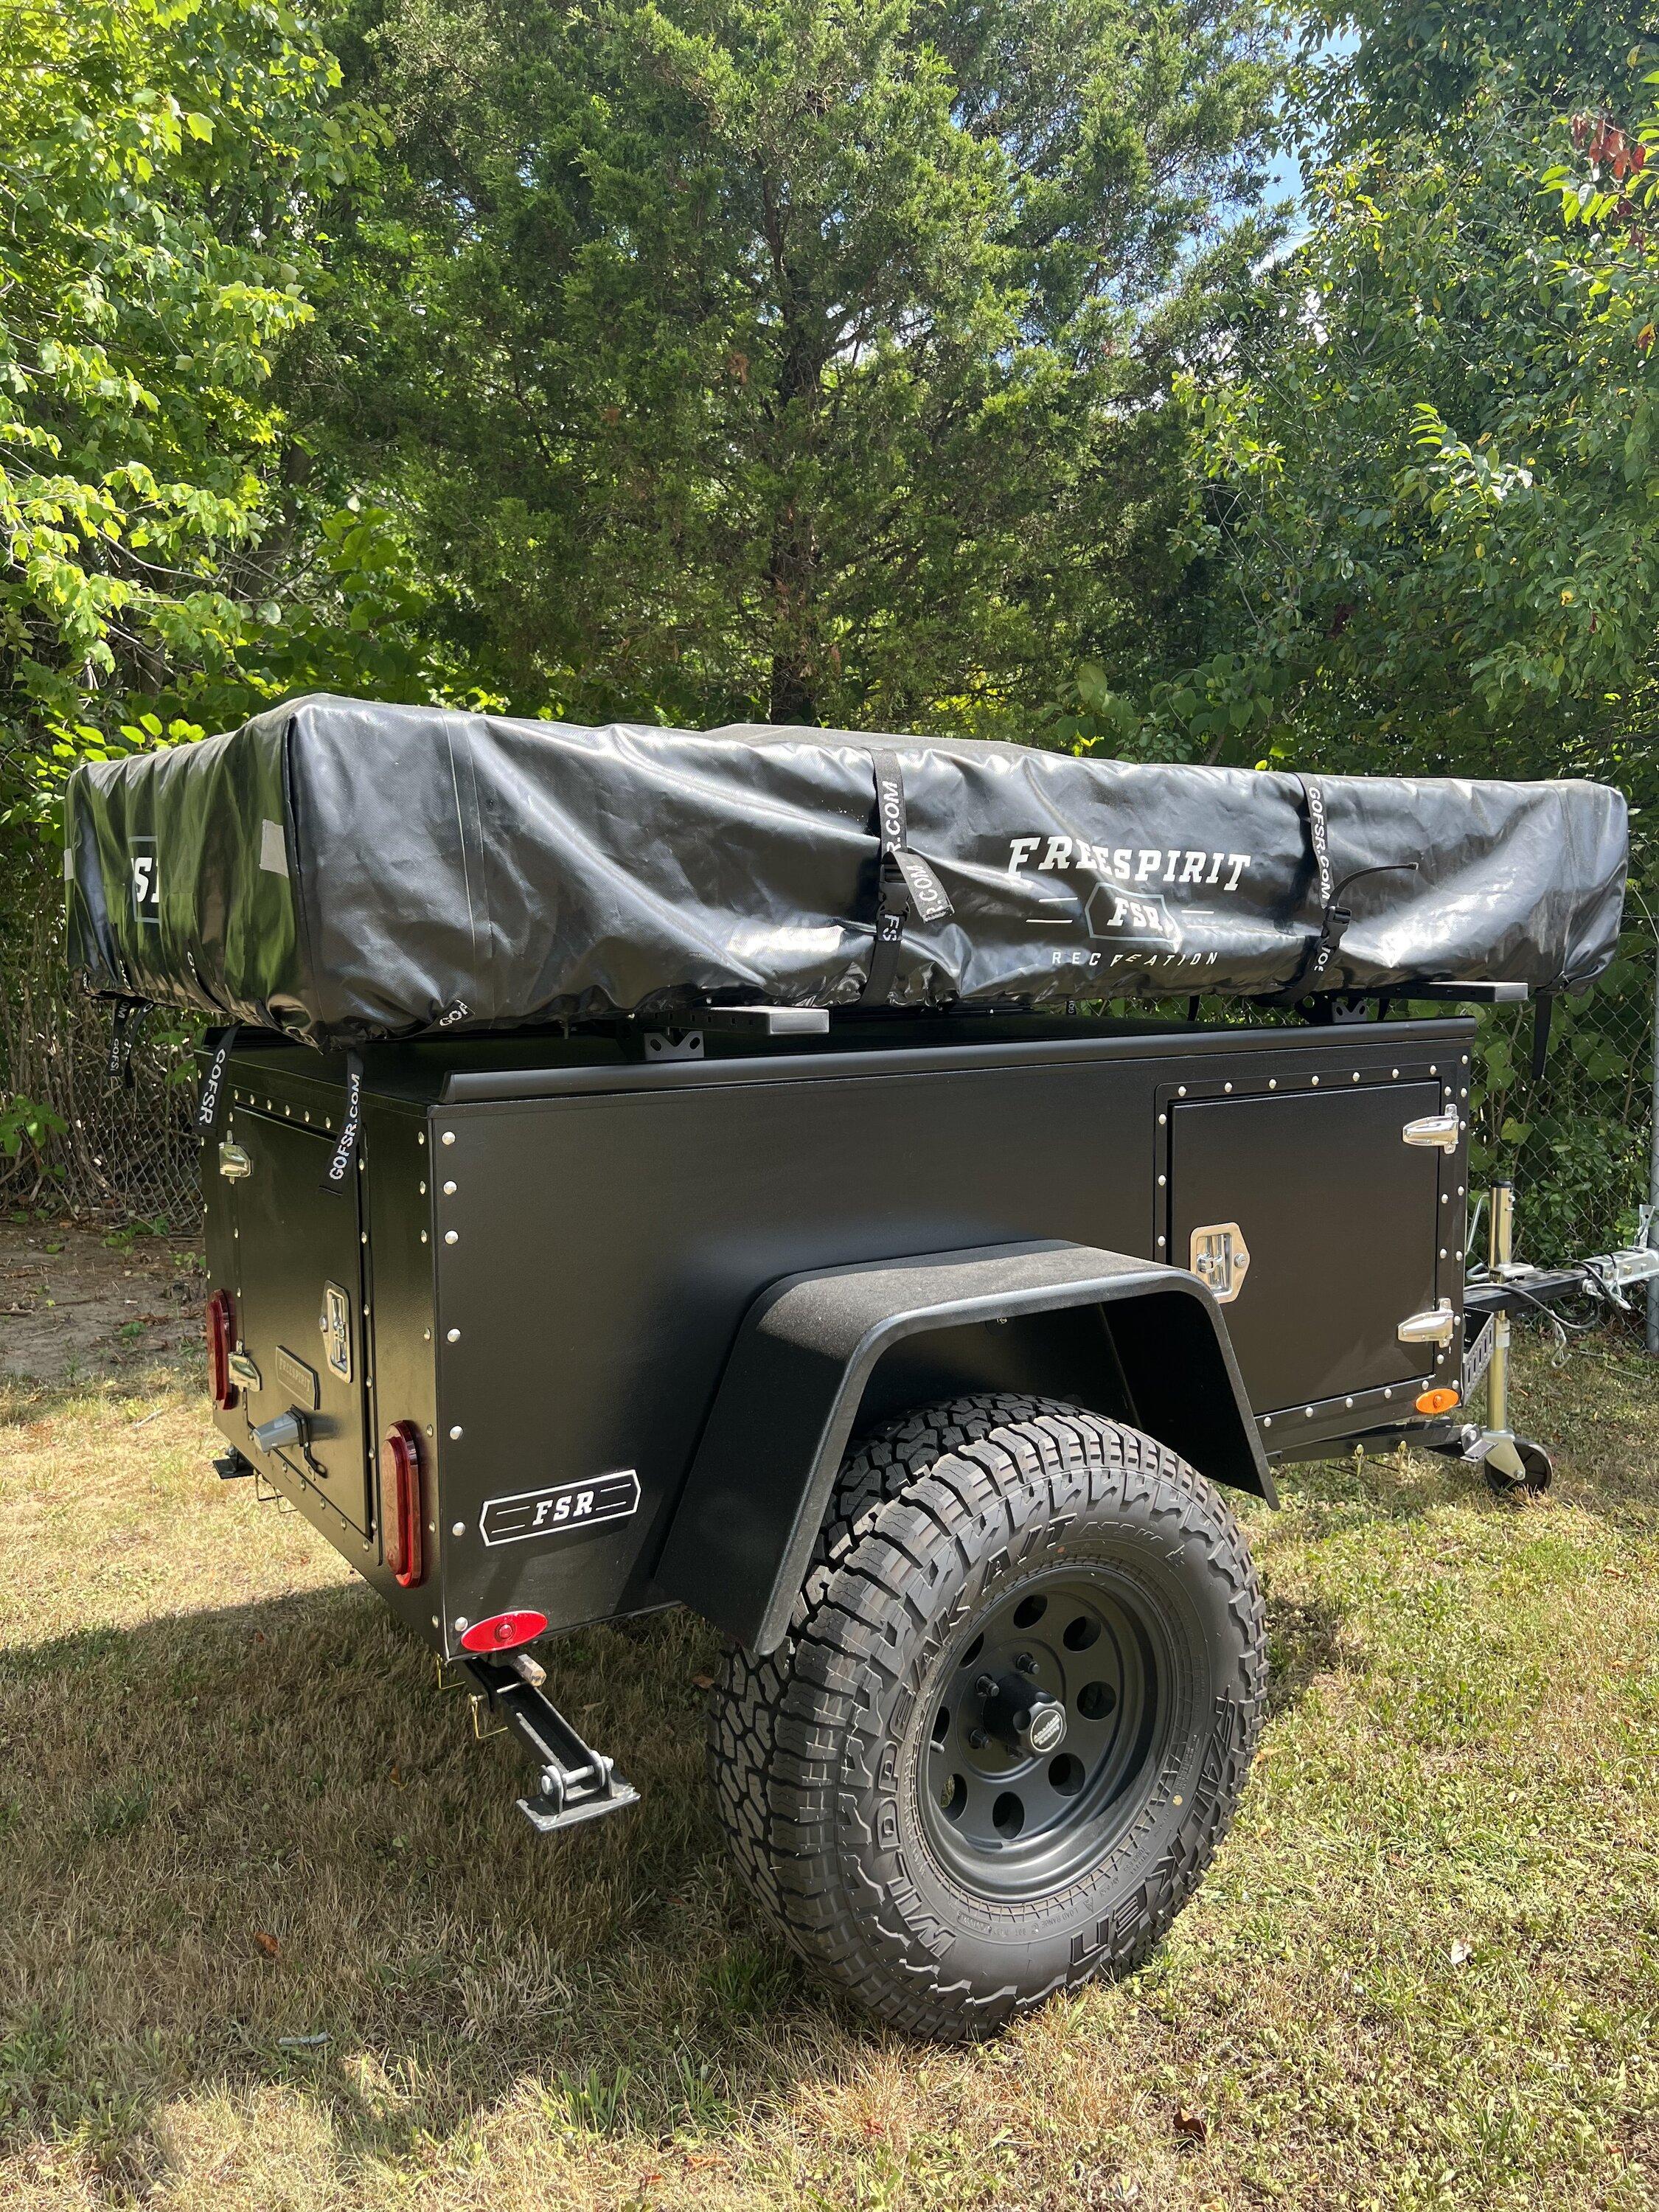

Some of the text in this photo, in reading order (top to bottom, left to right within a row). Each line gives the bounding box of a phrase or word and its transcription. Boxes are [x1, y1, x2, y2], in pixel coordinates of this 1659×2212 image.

[1006, 835, 1251, 891] FREESPIRIT
[1309, 786, 1330, 900] GOFSR.COM
[329, 1073, 361, 1180] GOFSR.COM
[532, 1490, 594, 1526] FSR
